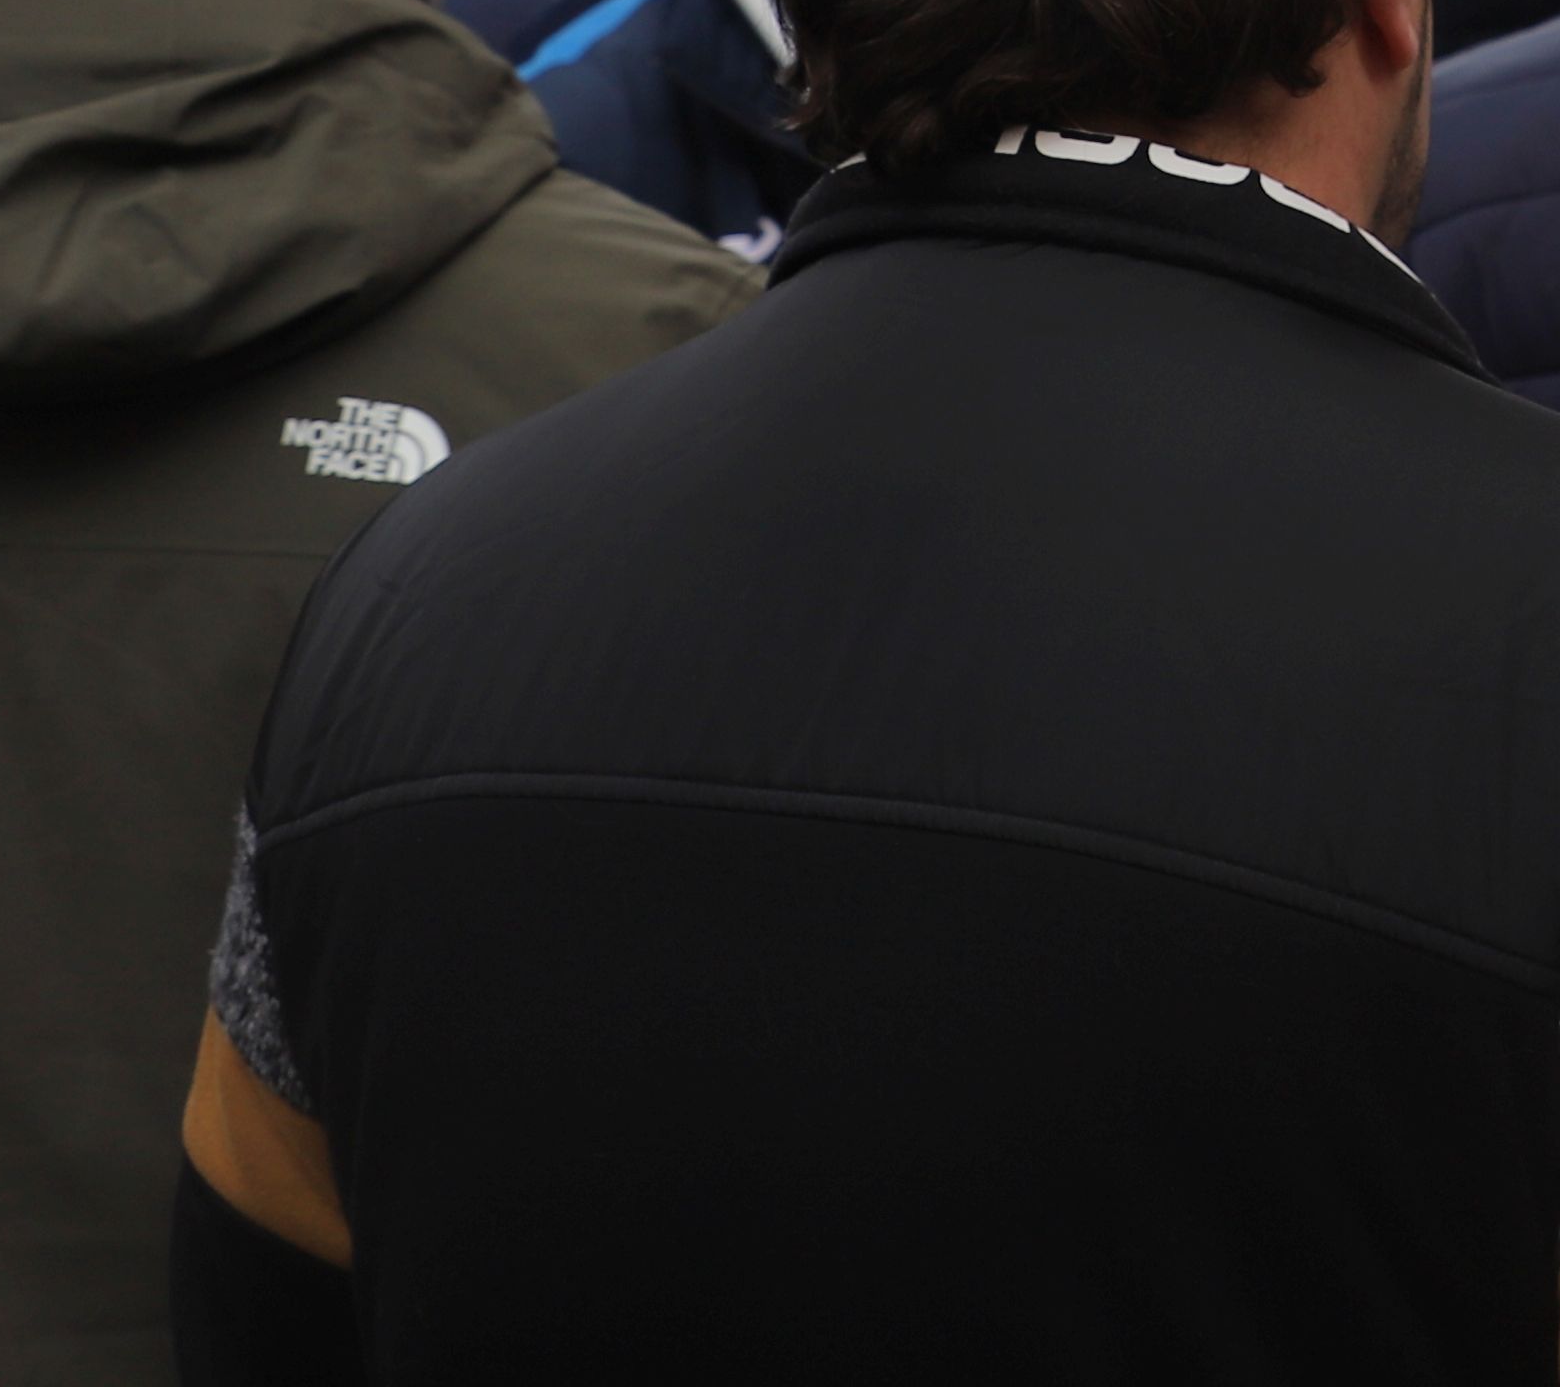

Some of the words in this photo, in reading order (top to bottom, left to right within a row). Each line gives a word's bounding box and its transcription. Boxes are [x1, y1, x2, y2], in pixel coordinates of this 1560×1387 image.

[337, 395, 402, 432] THE
[280, 416, 394, 456] NORTH
[304, 446, 389, 483] FACE
